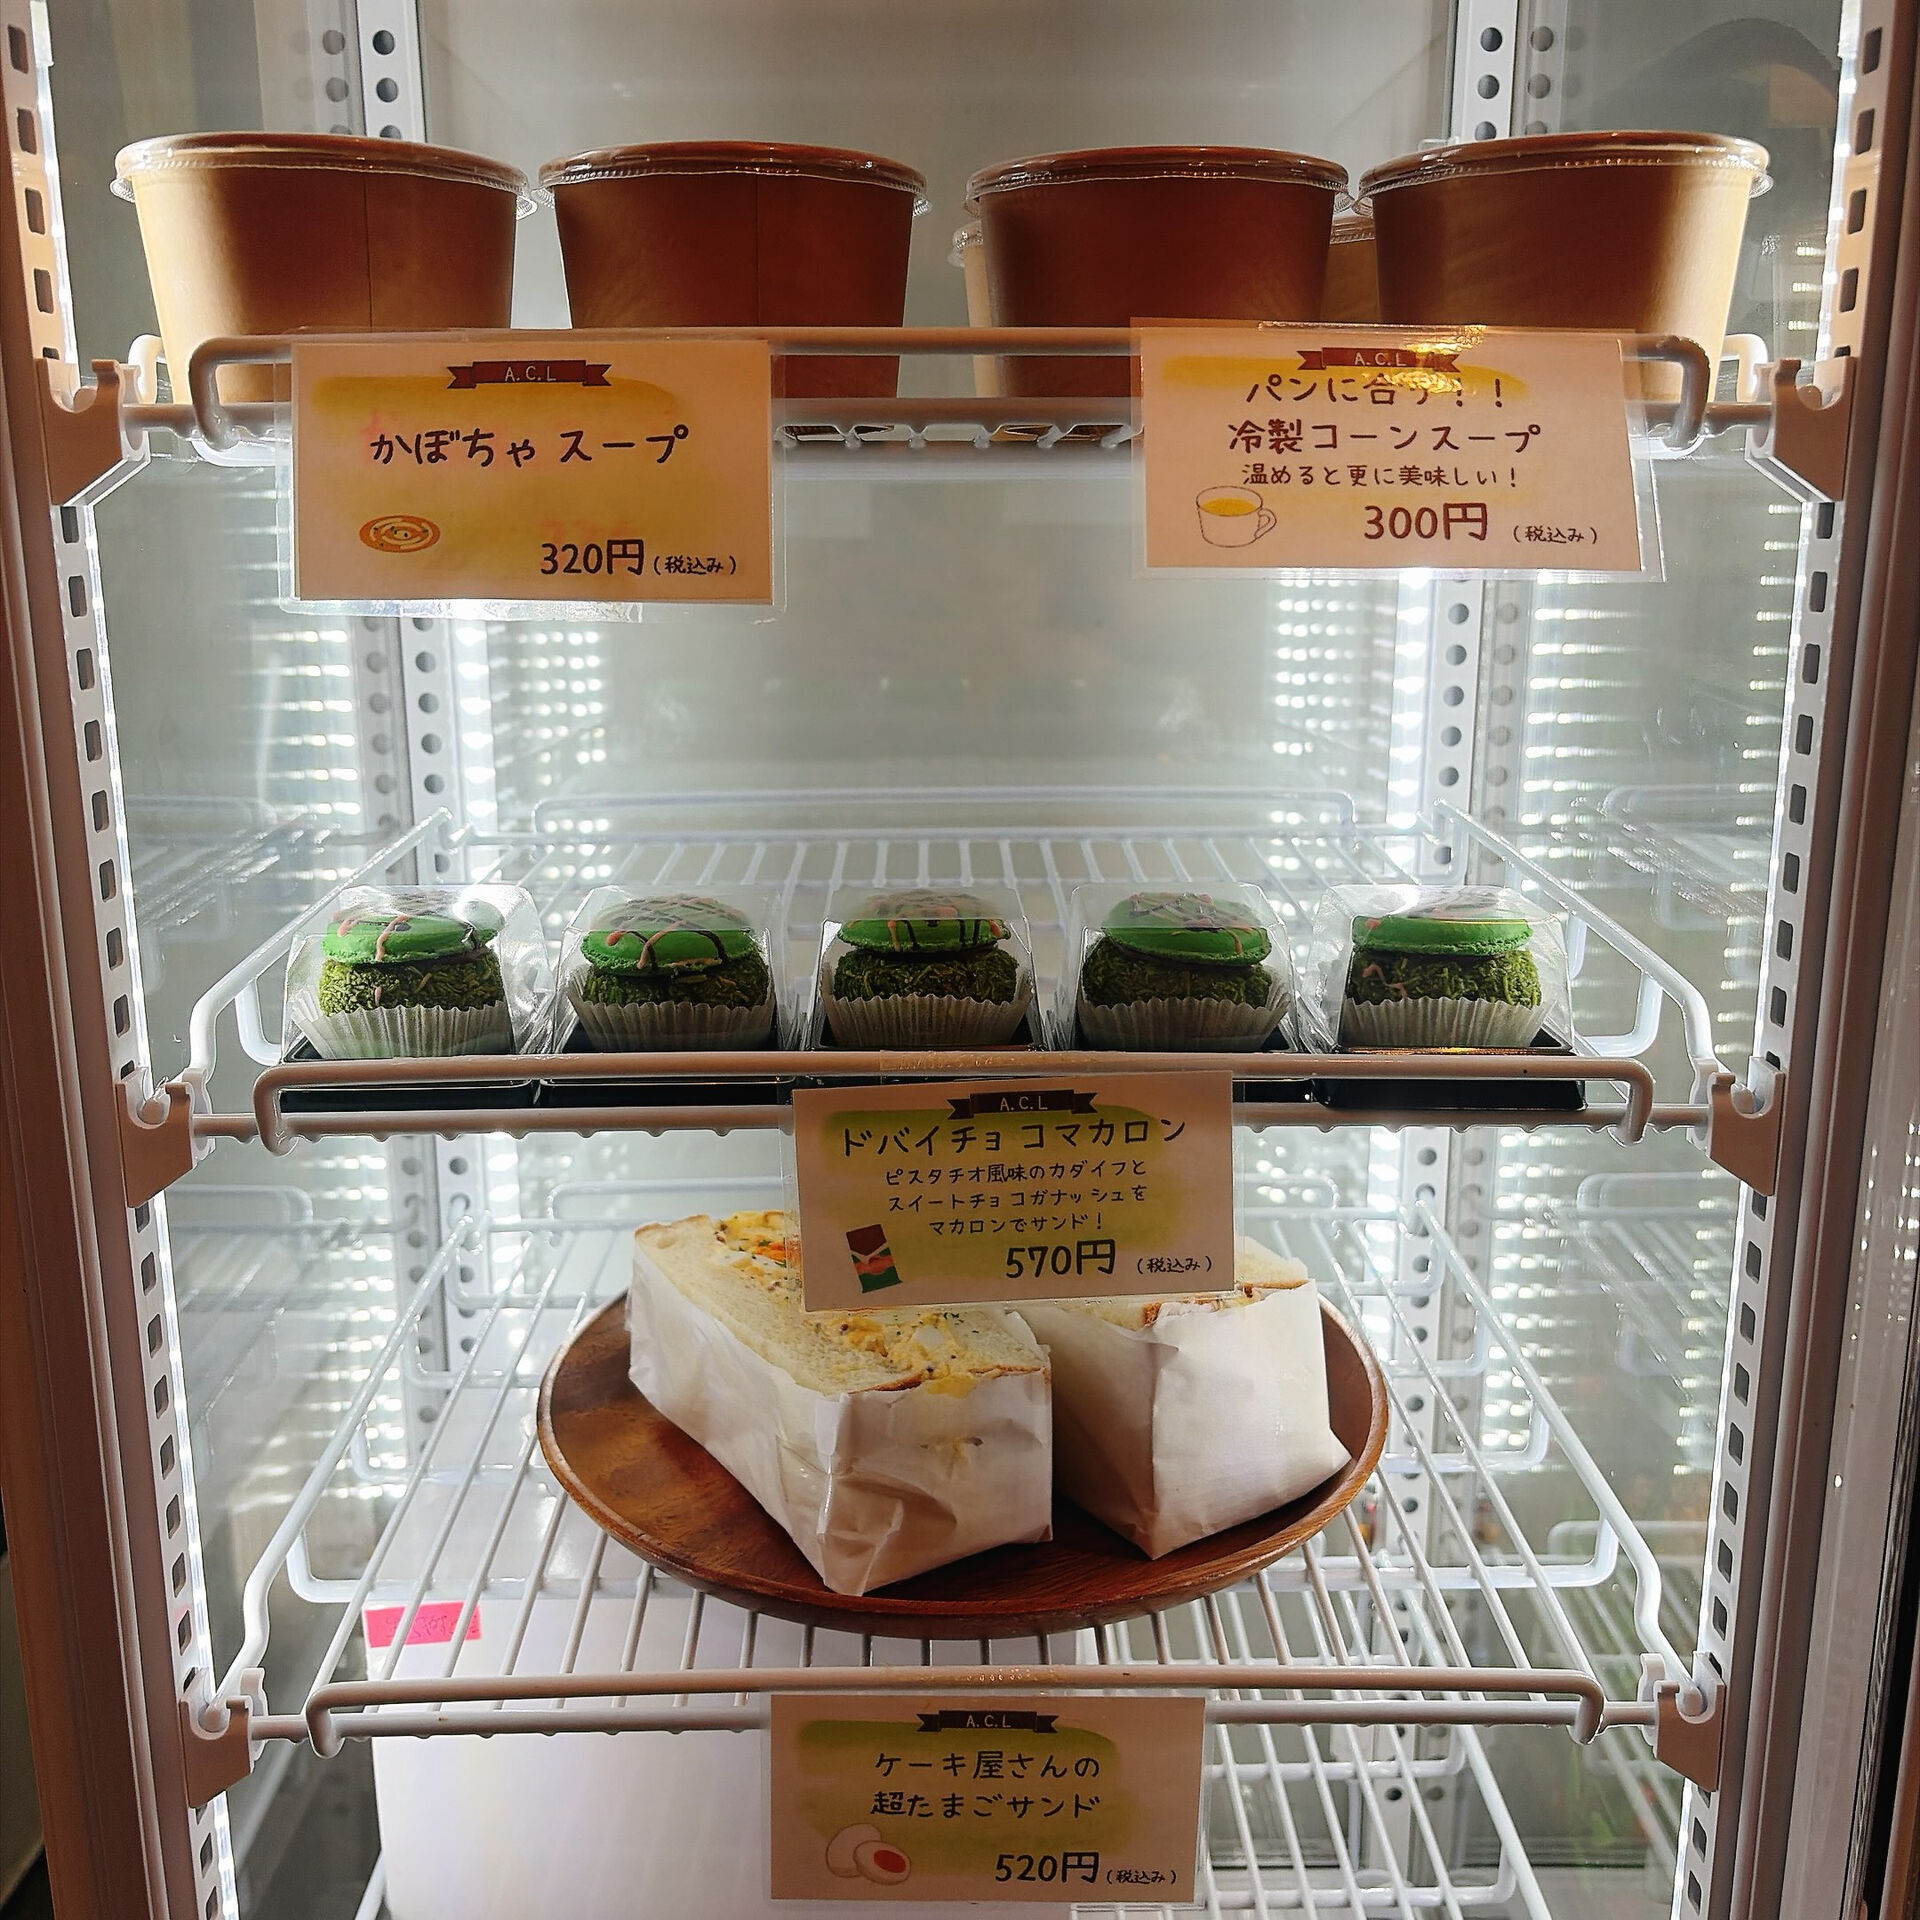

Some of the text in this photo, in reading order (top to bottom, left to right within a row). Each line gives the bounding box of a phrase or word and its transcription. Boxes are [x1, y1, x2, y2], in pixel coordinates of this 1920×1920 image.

[371, 424, 688, 467] かぼちゃスープ
[1228, 419, 1540, 454] 冷製コーンスープ
[1242, 463, 1517, 488] 温めると更に美味しい！
[1364, 503, 1597, 544] 300円 （税込み）
[541, 539, 736, 575] 320円 （税込み）
[844, 1117, 1186, 1158] ドバイチョコマカロン
[886, 1159, 1147, 1187] ピスタチオ風味のカダイフと
[888, 1184, 1147, 1212] スイートチョコガナッシュを
[930, 1213, 1101, 1235] マカロンでサンド！
[1007, 1239, 1211, 1278] 570円 （税込み）
[876, 1751, 1099, 1779] ケーキ屋さんの
[870, 1792, 1100, 1818] 超たまごサンド
[996, 1852, 1176, 1884] 520円 （税込み）
